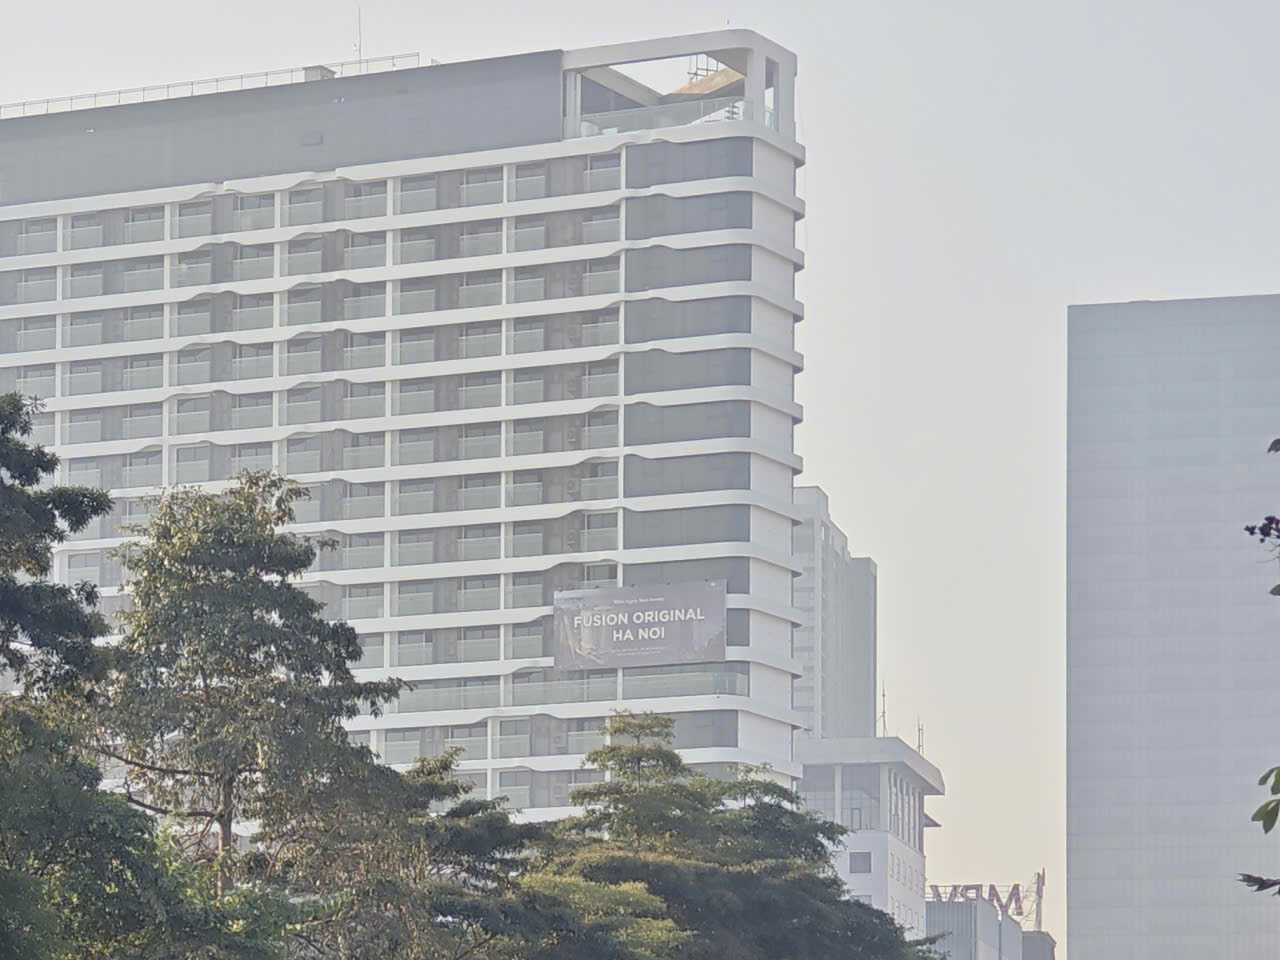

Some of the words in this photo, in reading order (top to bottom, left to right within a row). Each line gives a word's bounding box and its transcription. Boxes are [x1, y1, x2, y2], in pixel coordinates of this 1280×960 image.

[573, 612, 629, 628] FUSION
[632, 607, 705, 624] ORIGINAL
[612, 628, 634, 642] HA
[638, 626, 665, 640] NOI
